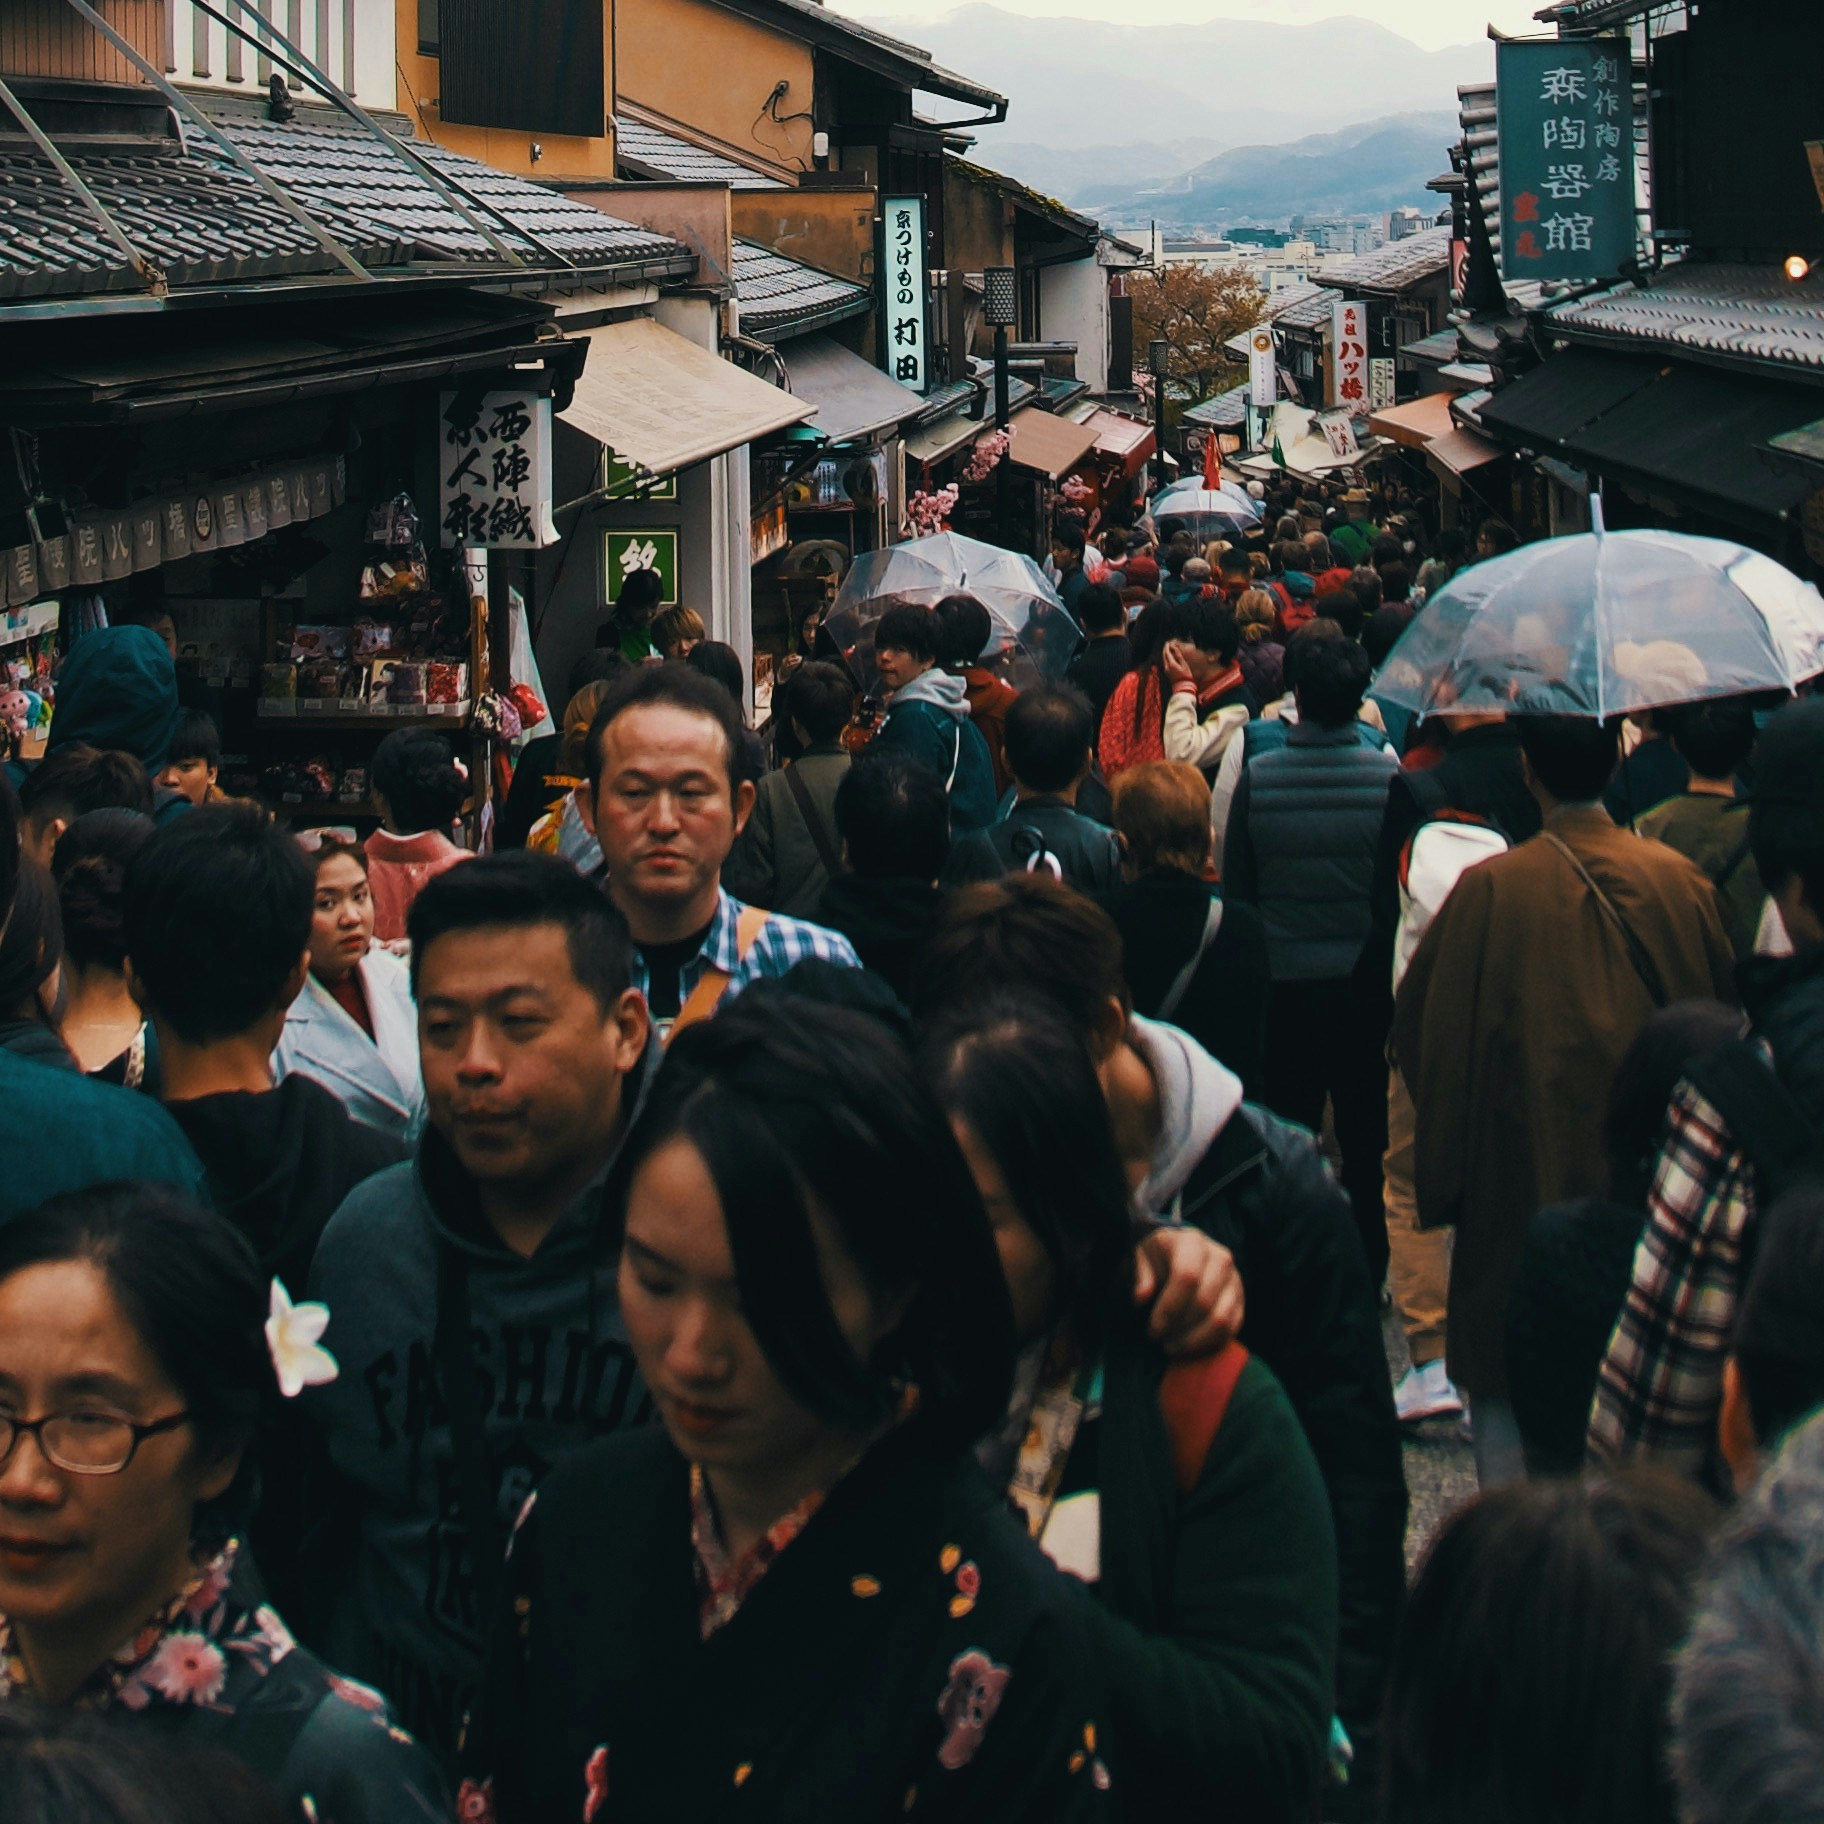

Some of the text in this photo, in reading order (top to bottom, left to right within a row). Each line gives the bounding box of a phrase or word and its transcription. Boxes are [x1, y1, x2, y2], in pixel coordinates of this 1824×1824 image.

[1538, 65, 1595, 253] 森陶器館
[1592, 54, 1622, 183] 創作陶房
[893, 208, 920, 383] 京つけもの 打田
[489, 400, 536, 542] 西陣織
[364, 1323, 652, 1451] FASHIO
